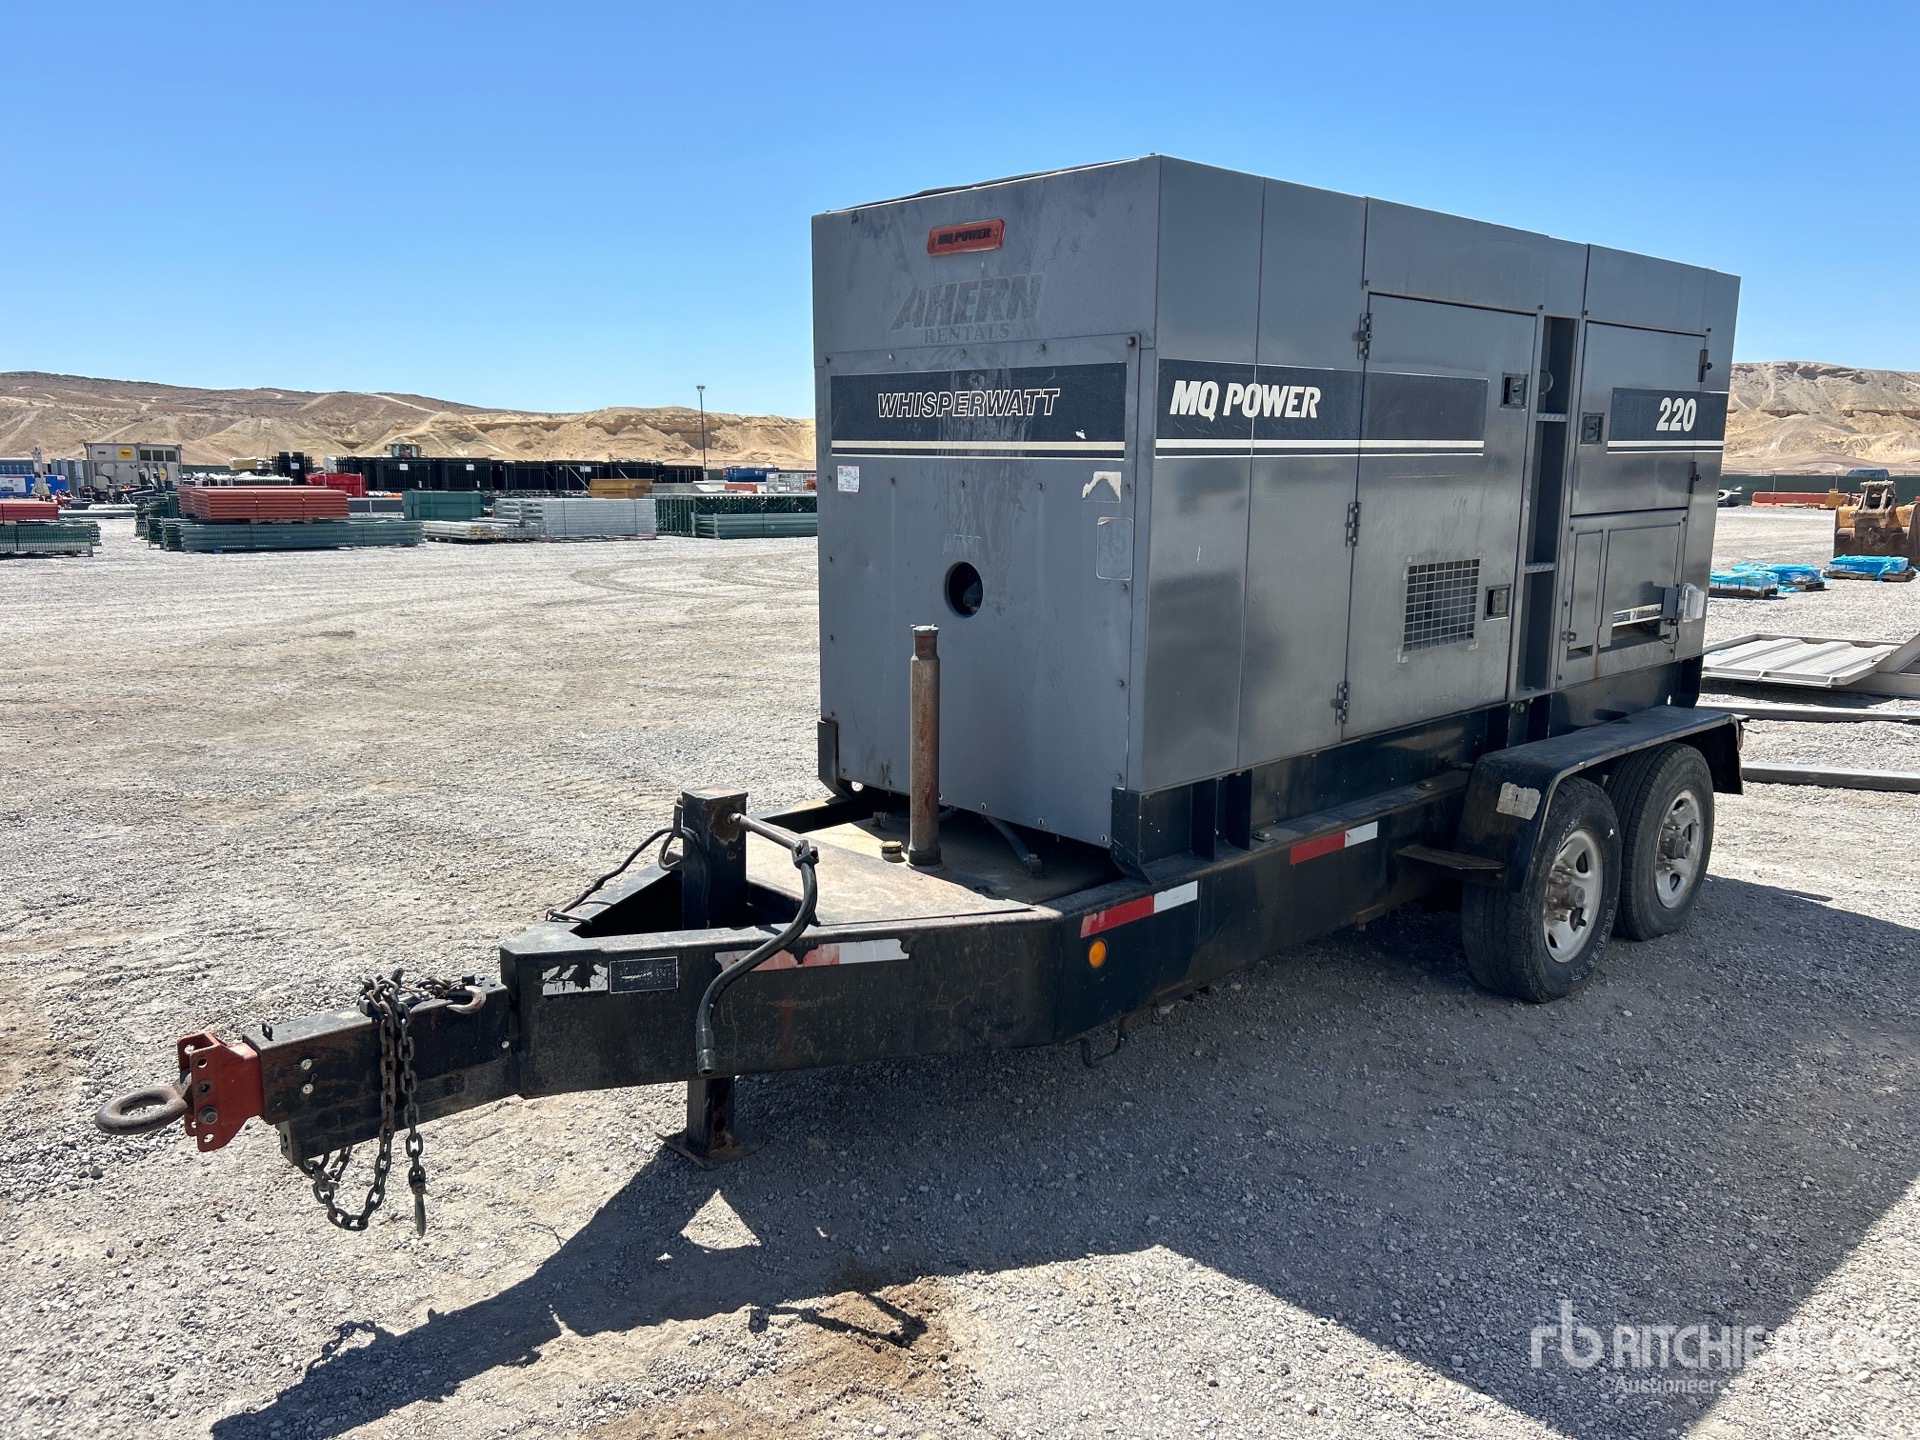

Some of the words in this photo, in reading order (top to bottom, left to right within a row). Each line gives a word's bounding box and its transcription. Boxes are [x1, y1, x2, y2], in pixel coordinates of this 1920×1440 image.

[889, 273, 1044, 330] AHERN
[924, 322, 1011, 344] RENTALS
[877, 388, 1061, 418] WHISPERWATT
[1169, 380, 1220, 422] MQ
[1222, 382, 1322, 418] POWER
[1655, 396, 1697, 432] 220
